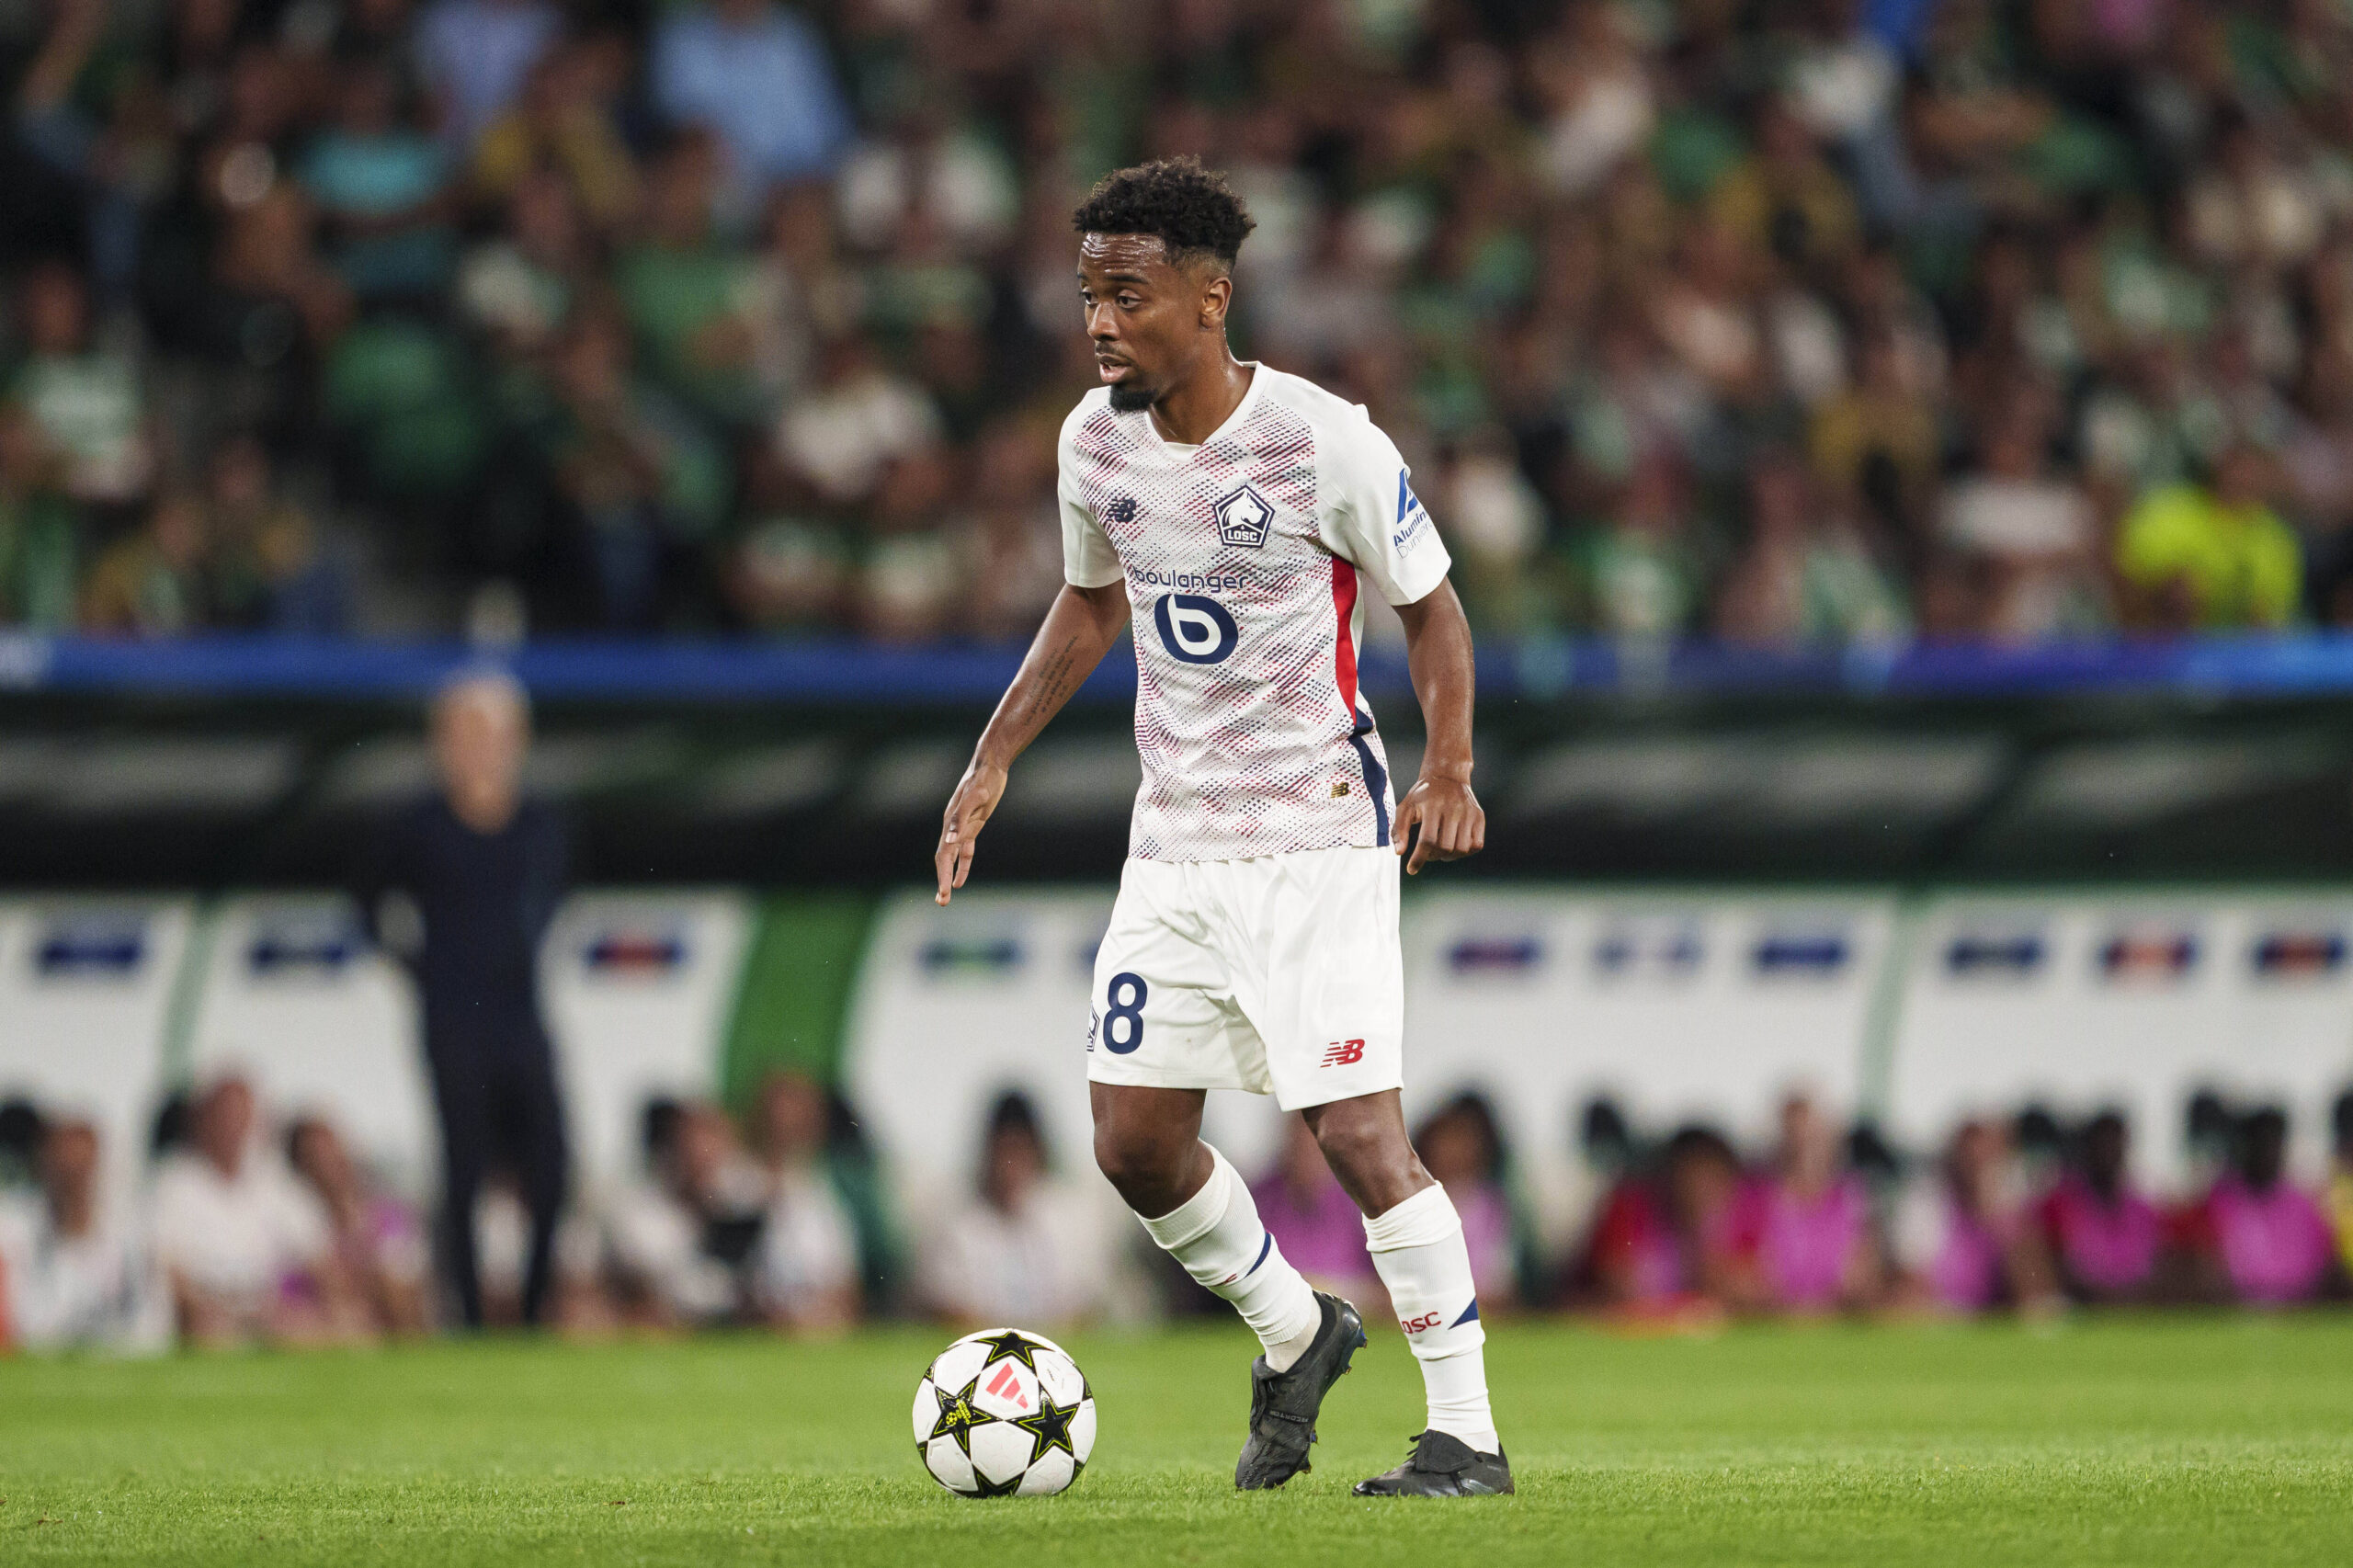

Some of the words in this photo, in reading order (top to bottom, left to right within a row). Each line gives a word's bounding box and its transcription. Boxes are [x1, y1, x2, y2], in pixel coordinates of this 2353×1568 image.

[1227, 529, 1258, 542] LOSC
[1132, 565, 1249, 594] boulanger
[1102, 971, 1149, 1056] 8
[1401, 1311, 1442, 1335] OSC
